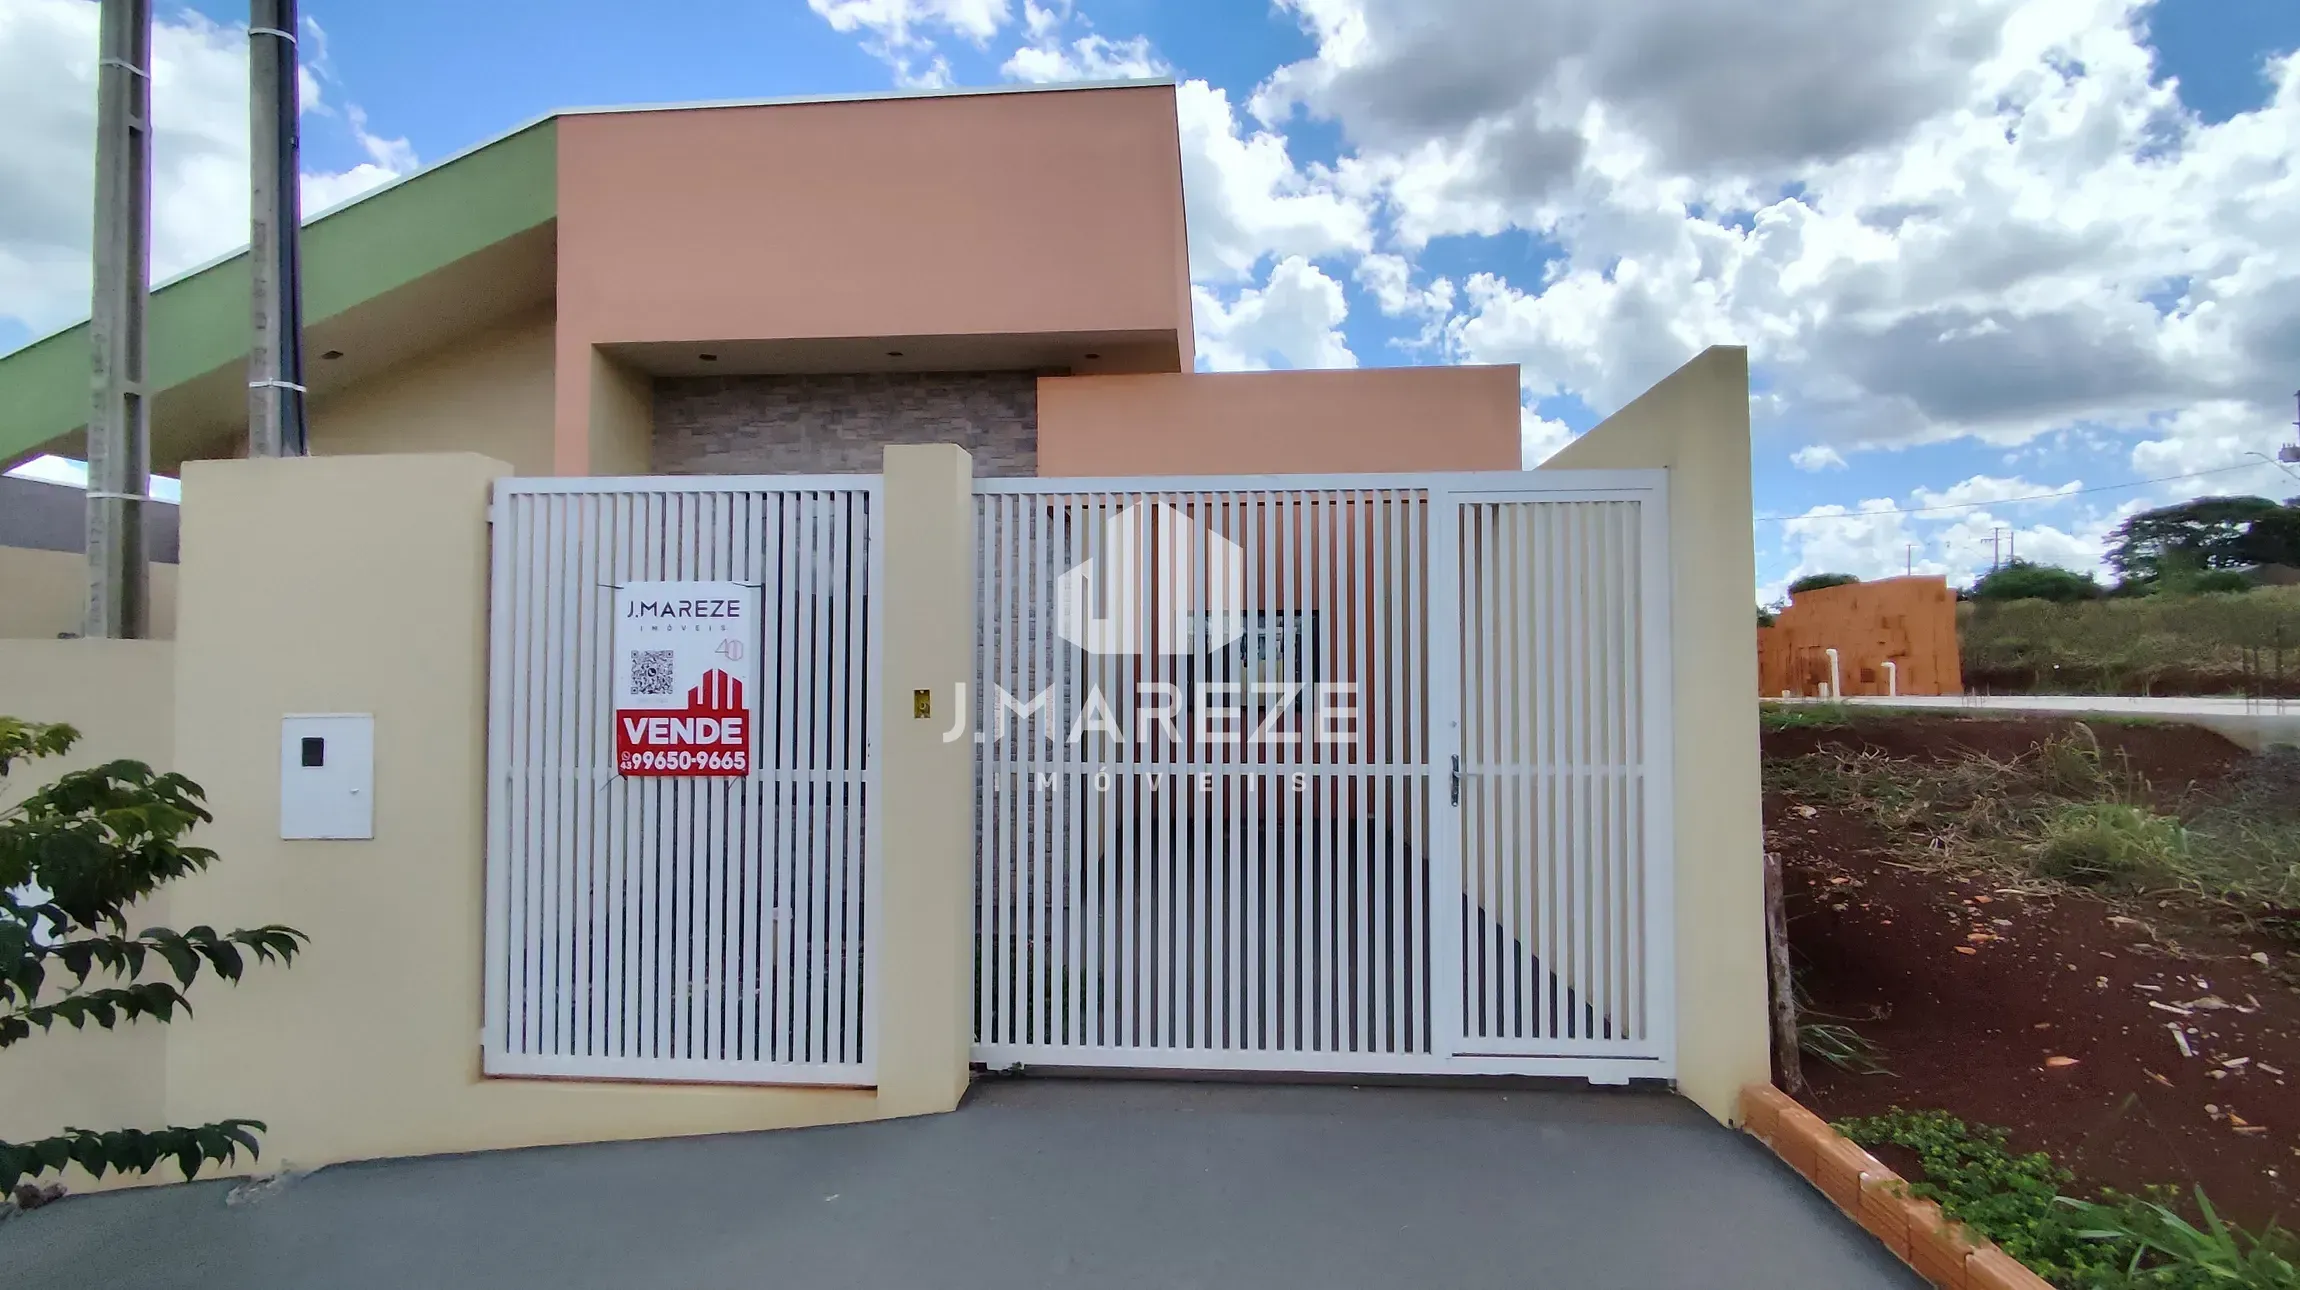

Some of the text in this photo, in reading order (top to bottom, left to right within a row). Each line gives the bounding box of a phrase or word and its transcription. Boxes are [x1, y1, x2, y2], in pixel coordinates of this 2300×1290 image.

[627, 600, 740, 618] J.MAREZE
[623, 717, 743, 745] VENDE
[632, 751, 746, 770] 99650-9665
